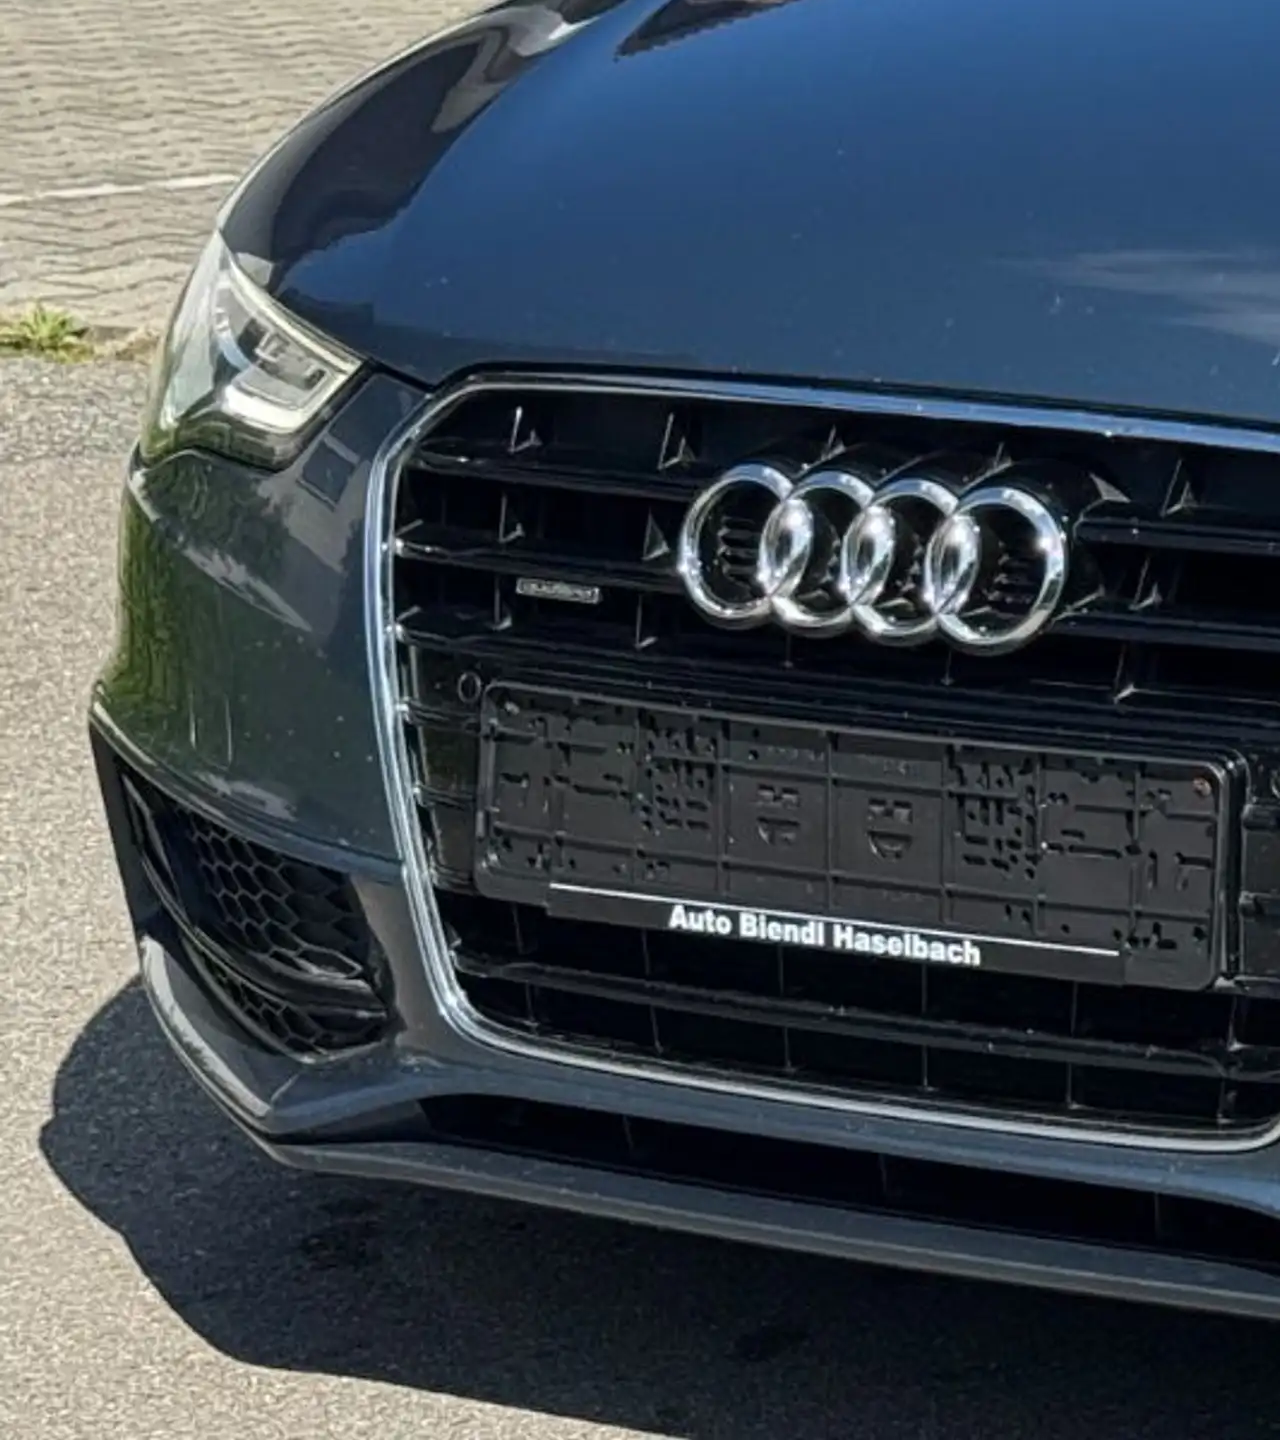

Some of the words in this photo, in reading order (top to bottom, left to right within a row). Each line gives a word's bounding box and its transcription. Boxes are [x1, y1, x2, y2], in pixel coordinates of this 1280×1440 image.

[668, 904, 731, 935] Auto
[738, 913, 826, 947] Biendl
[833, 926, 981, 967] Haselbach
